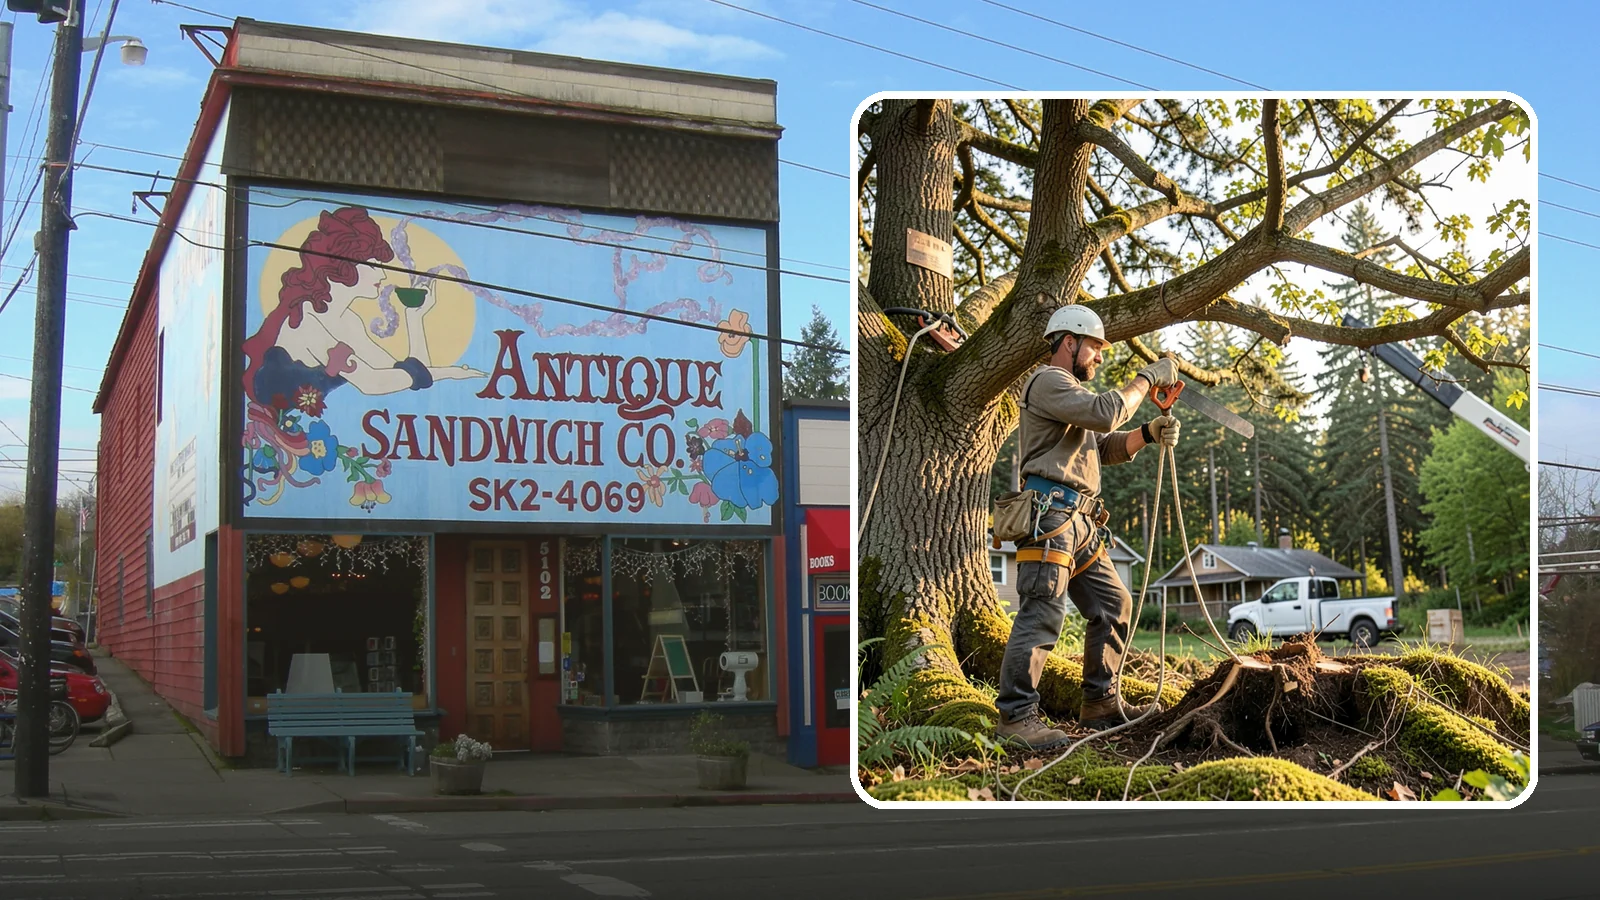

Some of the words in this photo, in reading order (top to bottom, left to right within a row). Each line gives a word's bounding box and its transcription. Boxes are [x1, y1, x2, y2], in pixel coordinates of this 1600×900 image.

[476, 329, 723, 420] ANTIQUE
[361, 409, 604, 467] SANDWICH
[617, 422, 685, 468] CO.
[468, 477, 645, 513] SK2-4069
[539, 542, 551, 599] 5102
[809, 555, 834, 568] BOOKS
